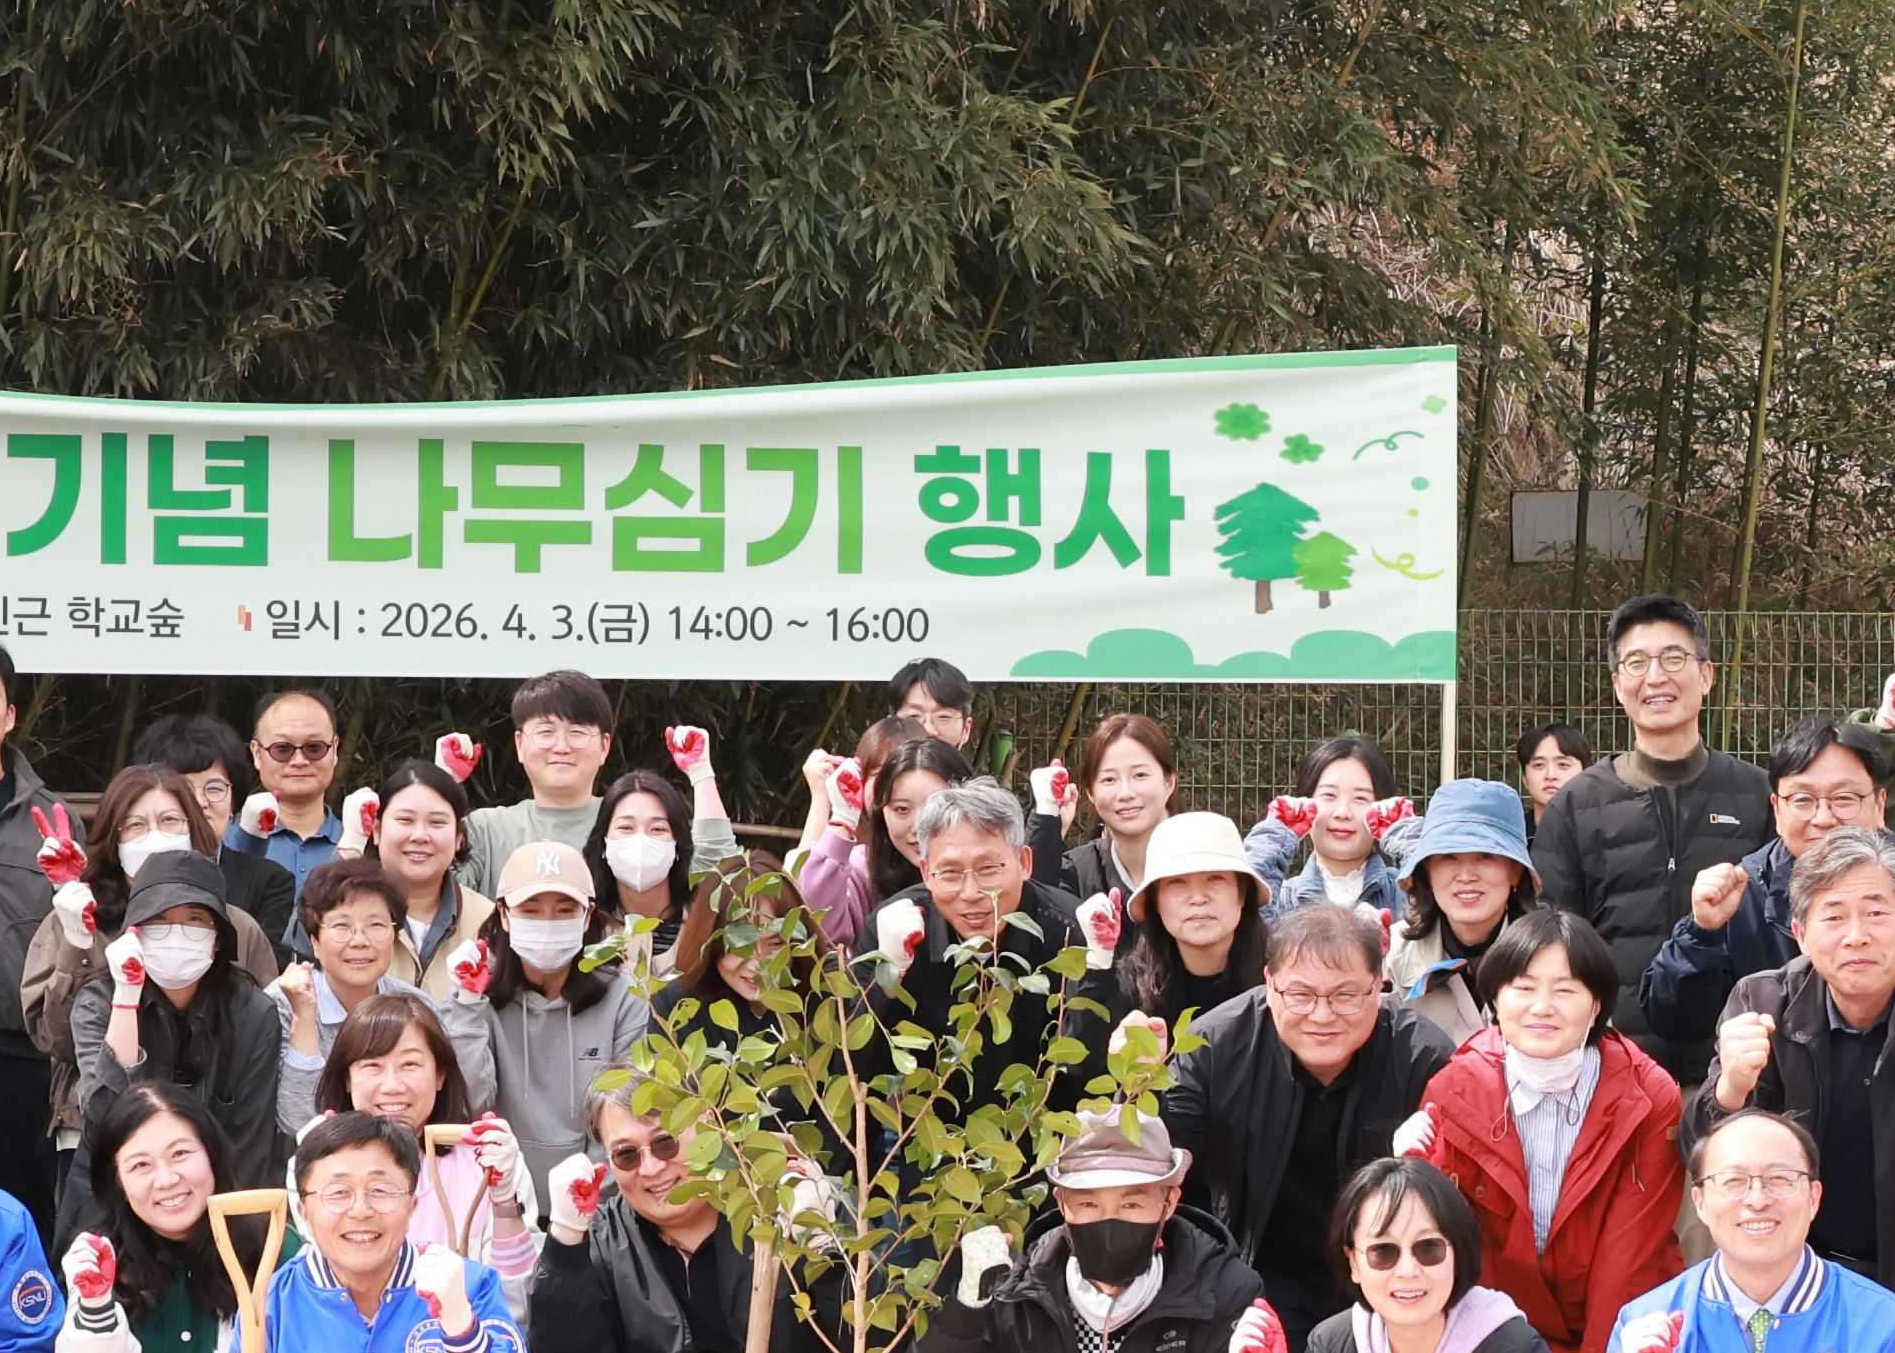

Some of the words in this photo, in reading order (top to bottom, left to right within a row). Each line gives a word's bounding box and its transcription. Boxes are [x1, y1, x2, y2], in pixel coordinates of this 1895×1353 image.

[7, 433, 270, 567] 기념
[328, 439, 863, 574] 나무심기
[914, 445, 1186, 577] 행사
[67, 596, 184, 638] 학교숲
[266, 599, 340, 641] 일시
[380, 602, 488, 641] 2026.
[502, 603, 536, 641] 4.
[551, 601, 650, 645] 3.(금)
[668, 606, 773, 642] 14:00
[826, 606, 930, 643] 16:00
